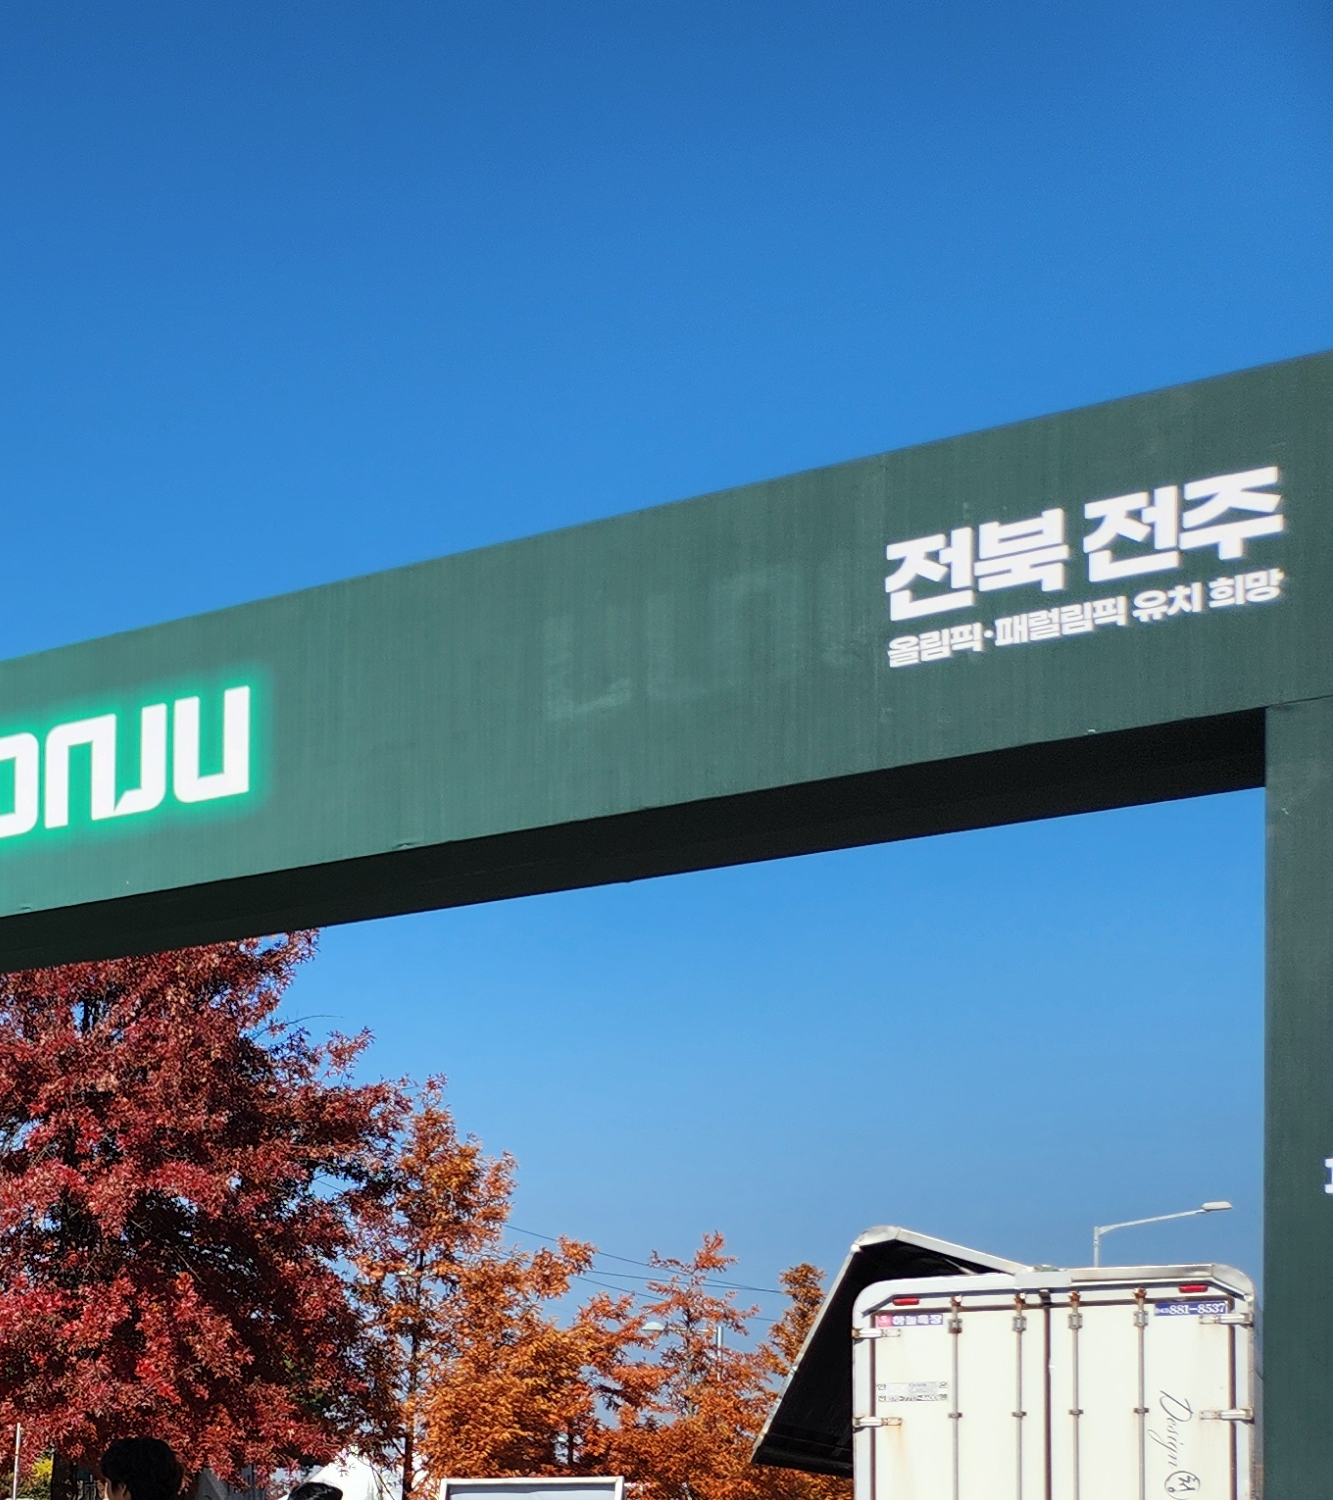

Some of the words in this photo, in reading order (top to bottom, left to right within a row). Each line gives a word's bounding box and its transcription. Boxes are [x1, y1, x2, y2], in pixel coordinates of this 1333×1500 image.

[885, 508, 1069, 621] 전북
[1083, 466, 1284, 582] 전주
[887, 596, 1127, 668] 올림픽·패럴림픽
[1132, 582, 1203, 622] 유치
[1208, 568, 1285, 608] 희망
[1148, 1390, 1194, 1468] Design
